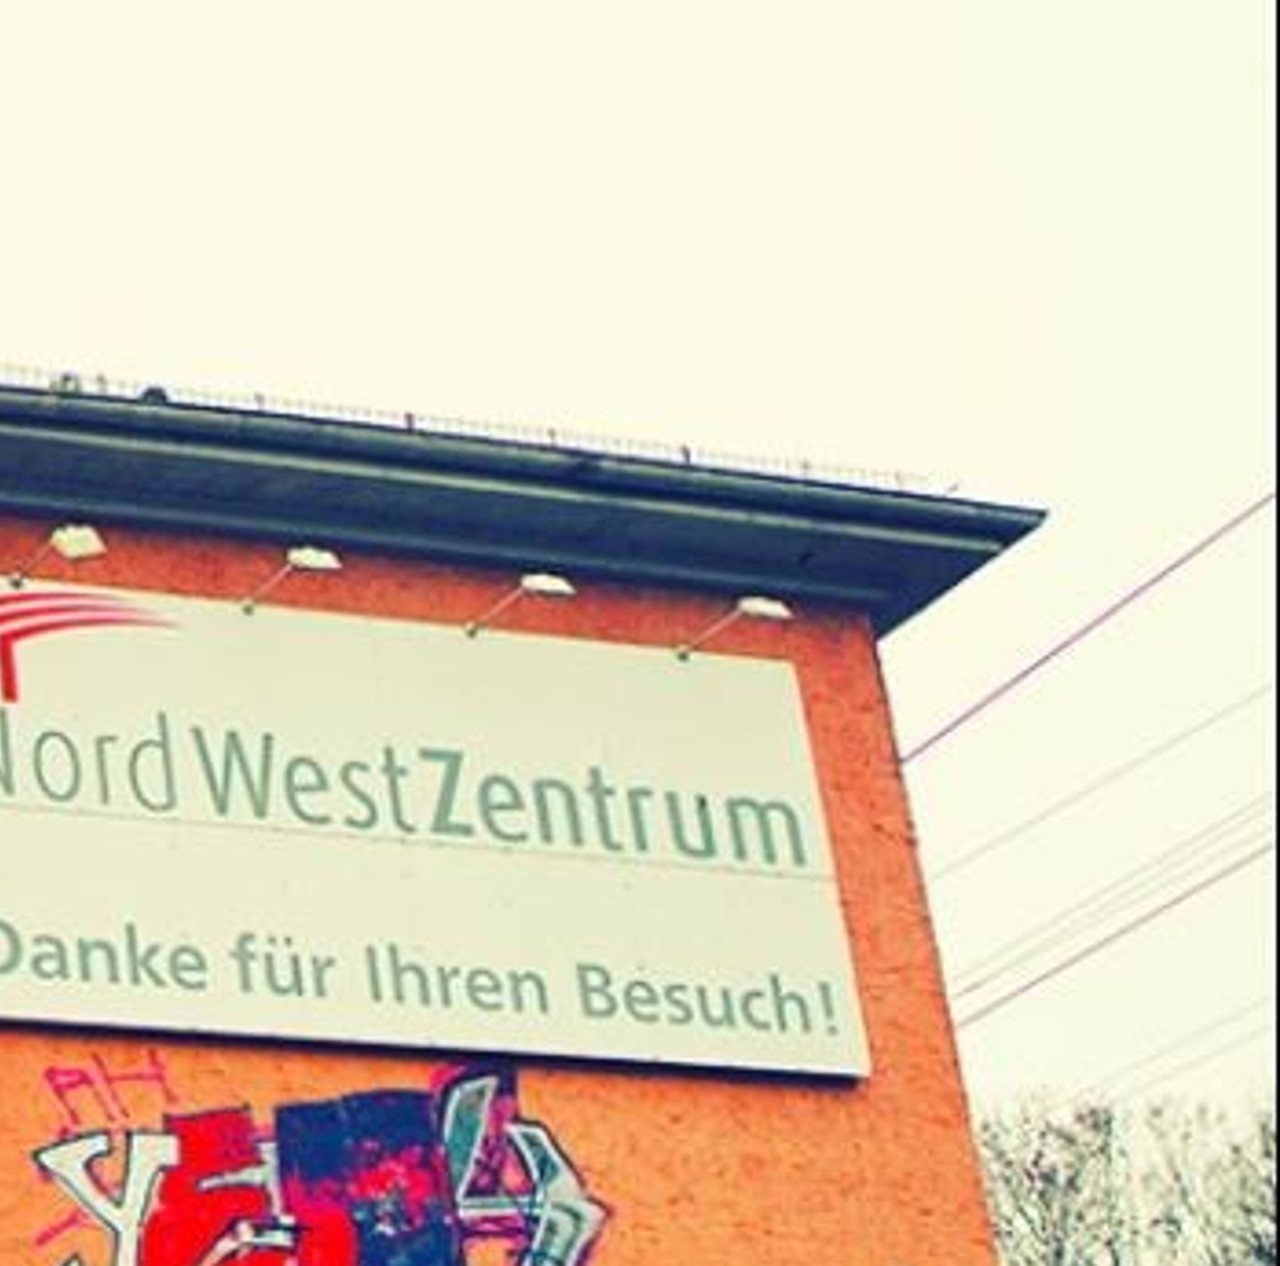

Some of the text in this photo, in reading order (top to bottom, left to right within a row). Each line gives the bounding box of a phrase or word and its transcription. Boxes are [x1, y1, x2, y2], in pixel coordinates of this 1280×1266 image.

[227, 932, 336, 999] für
[366, 944, 549, 1016] Ihren
[578, 959, 840, 1036] Besuch!
